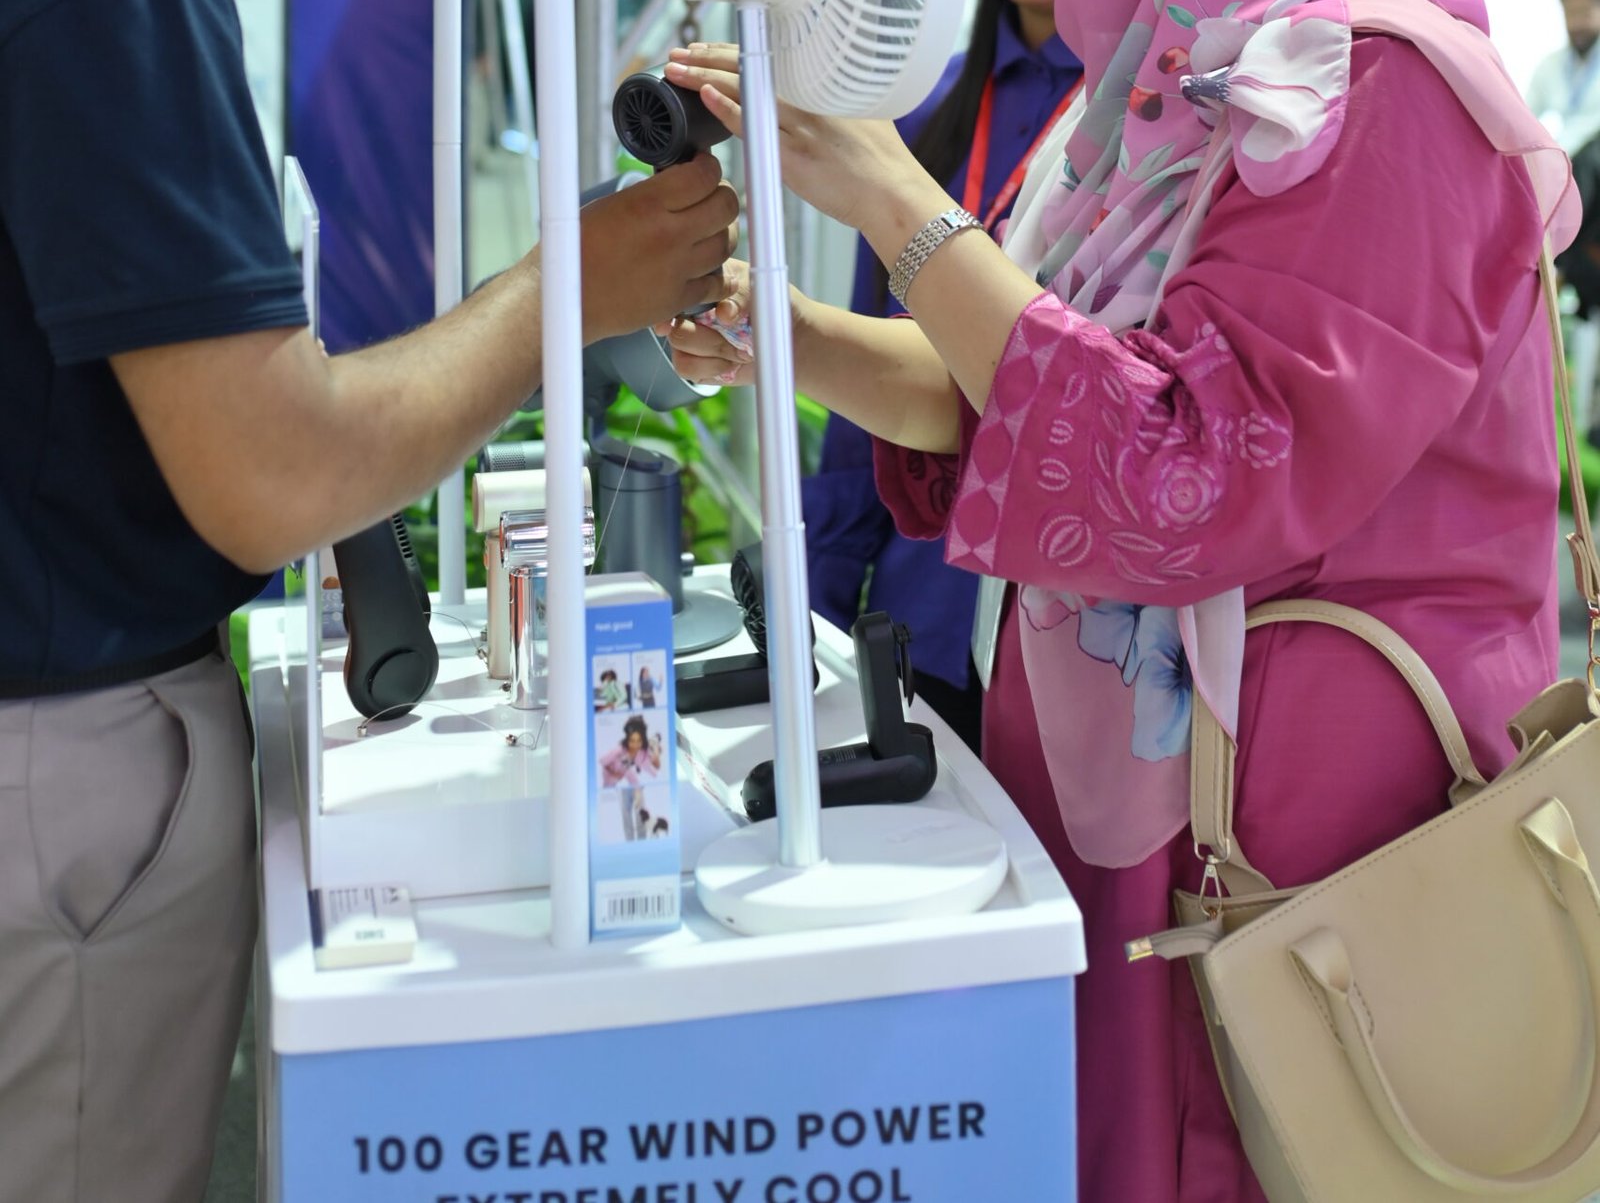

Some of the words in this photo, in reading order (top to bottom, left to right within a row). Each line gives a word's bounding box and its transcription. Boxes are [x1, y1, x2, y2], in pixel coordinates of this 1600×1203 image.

[353, 1135, 444, 1174] 100
[464, 1127, 608, 1171] GEAR
[628, 1115, 777, 1162] WIND
[797, 1101, 986, 1152] POWER
[763, 1167, 912, 1203] COOL
